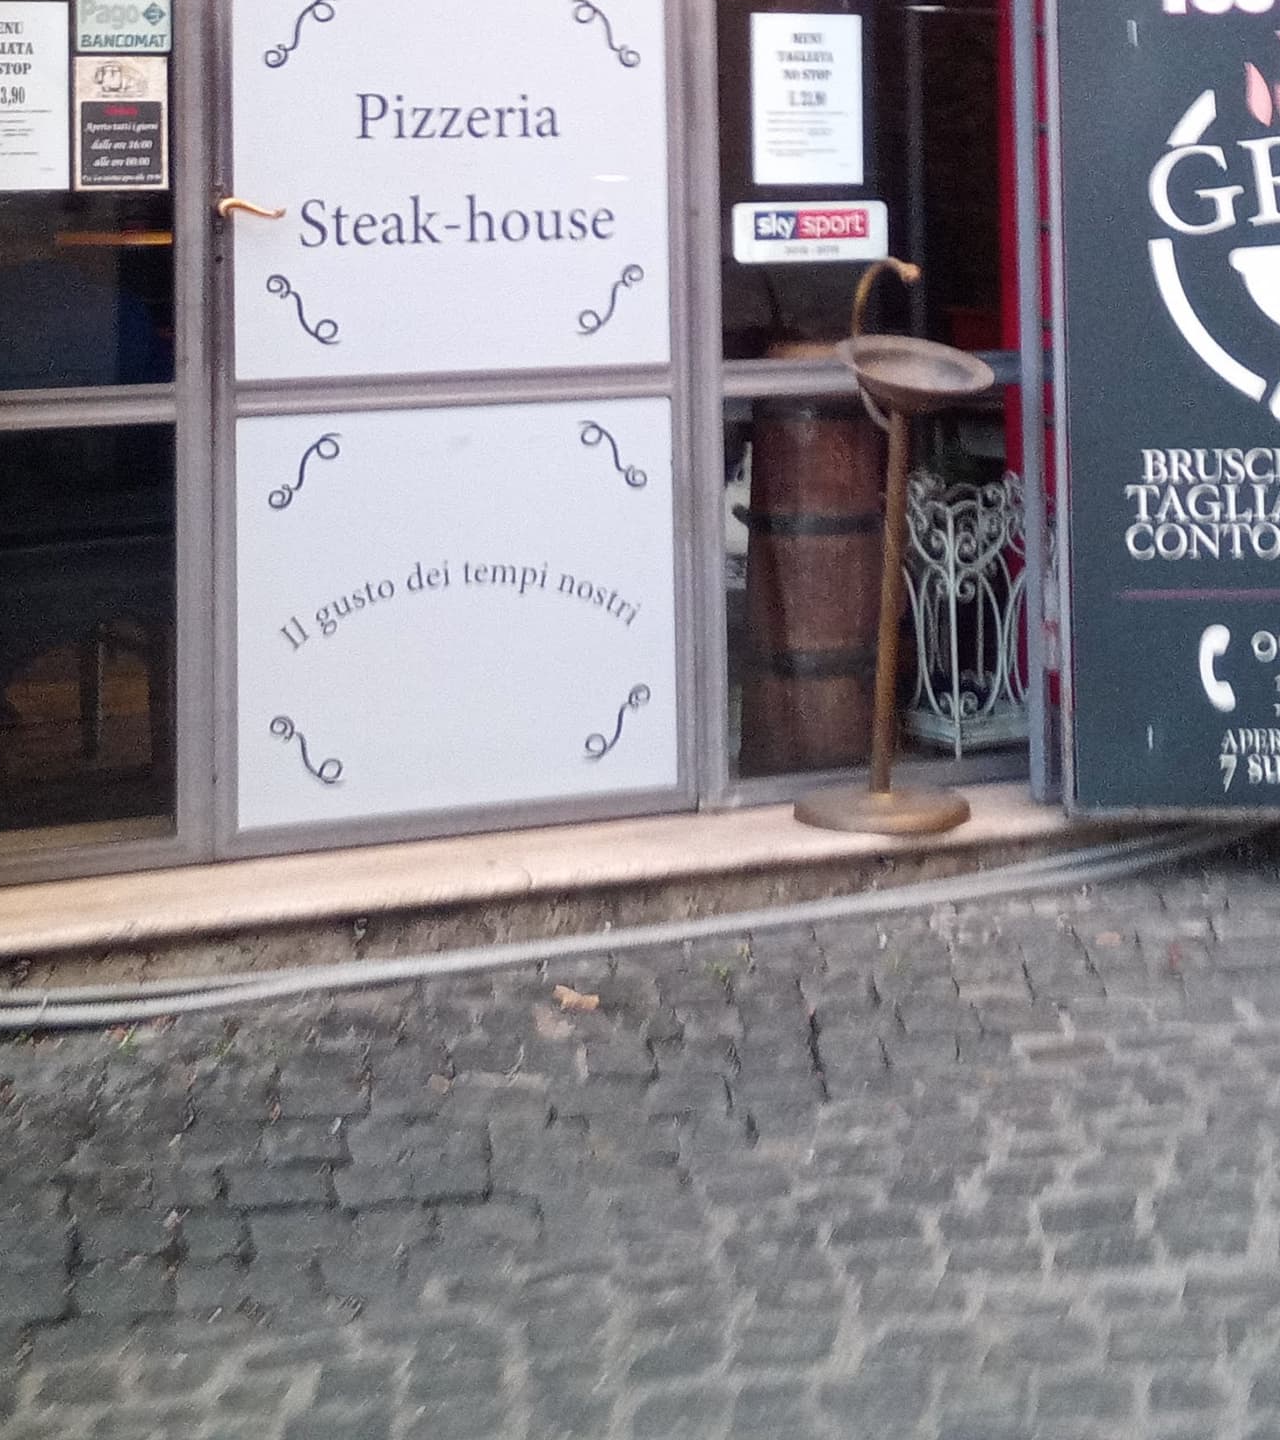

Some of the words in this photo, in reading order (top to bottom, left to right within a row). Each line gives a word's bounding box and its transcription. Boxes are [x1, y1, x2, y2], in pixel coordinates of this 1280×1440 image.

[81, 0, 139, 30] Pago
[81, 34, 167, 48] BANCOMAT
[355, 91, 560, 141] Pizzeria
[299, 194, 616, 250] Steak-house
[757, 213, 796, 238] sky
[801, 212, 864, 238] sport
[280, 619, 310, 652] Il
[314, 574, 395, 639] gusto
[407, 560, 450, 593] dei
[463, 560, 548, 596] tempi
[559, 572, 641, 627] nostri
[1220, 754, 1237, 792] 7
